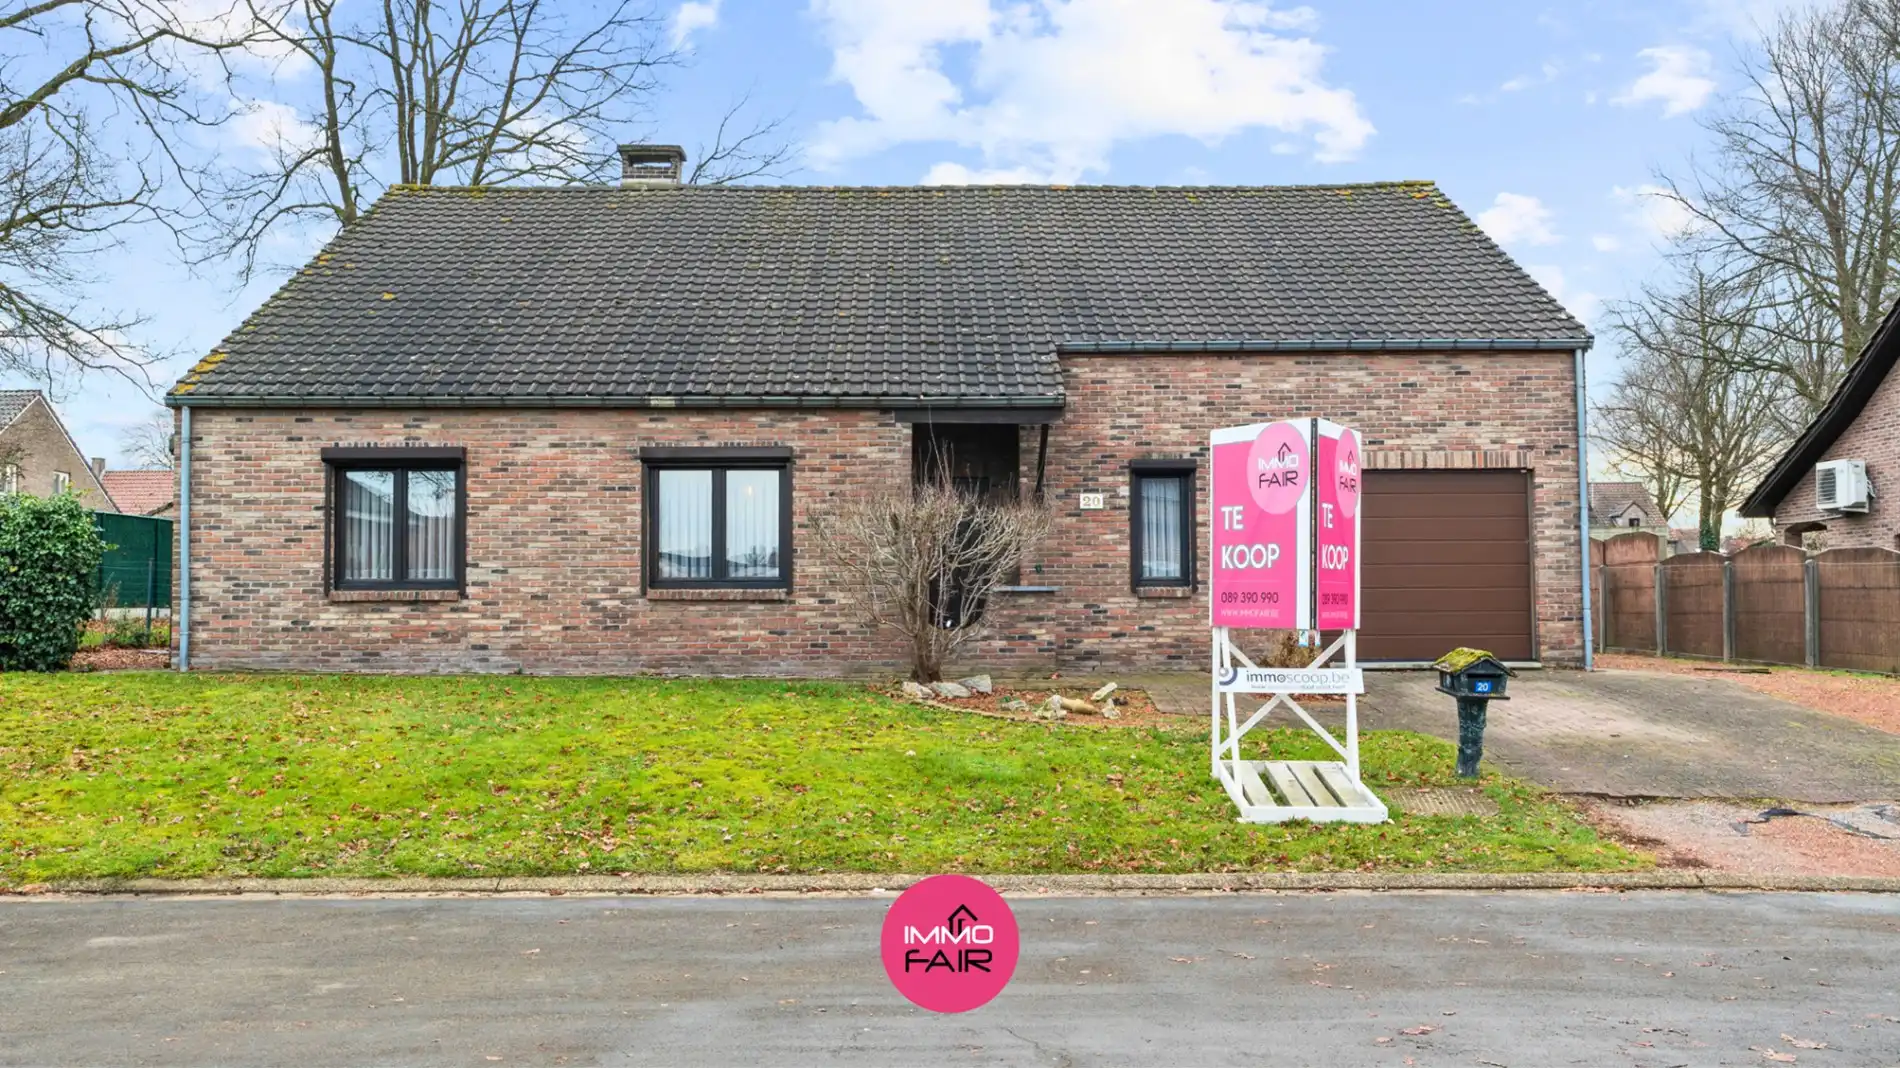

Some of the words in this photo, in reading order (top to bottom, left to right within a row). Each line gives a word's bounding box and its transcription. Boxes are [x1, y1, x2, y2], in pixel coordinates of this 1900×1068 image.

[1258, 454, 1299, 471] IMMO
[1258, 470, 1299, 489] FAIR
[1339, 475, 1357, 494] FAIR
[1083, 496, 1100, 506] 20
[1220, 505, 1244, 530] TE
[1321, 503, 1334, 528] TE
[1221, 543, 1280, 569] KOOP
[1321, 544, 1349, 570] KOOP
[1221, 592, 1238, 603] 089
[1240, 592, 1258, 603] 390
[1260, 592, 1279, 604] 990
[1246, 670, 1350, 685] immoscoop.be
[1477, 682, 1489, 692] 20
